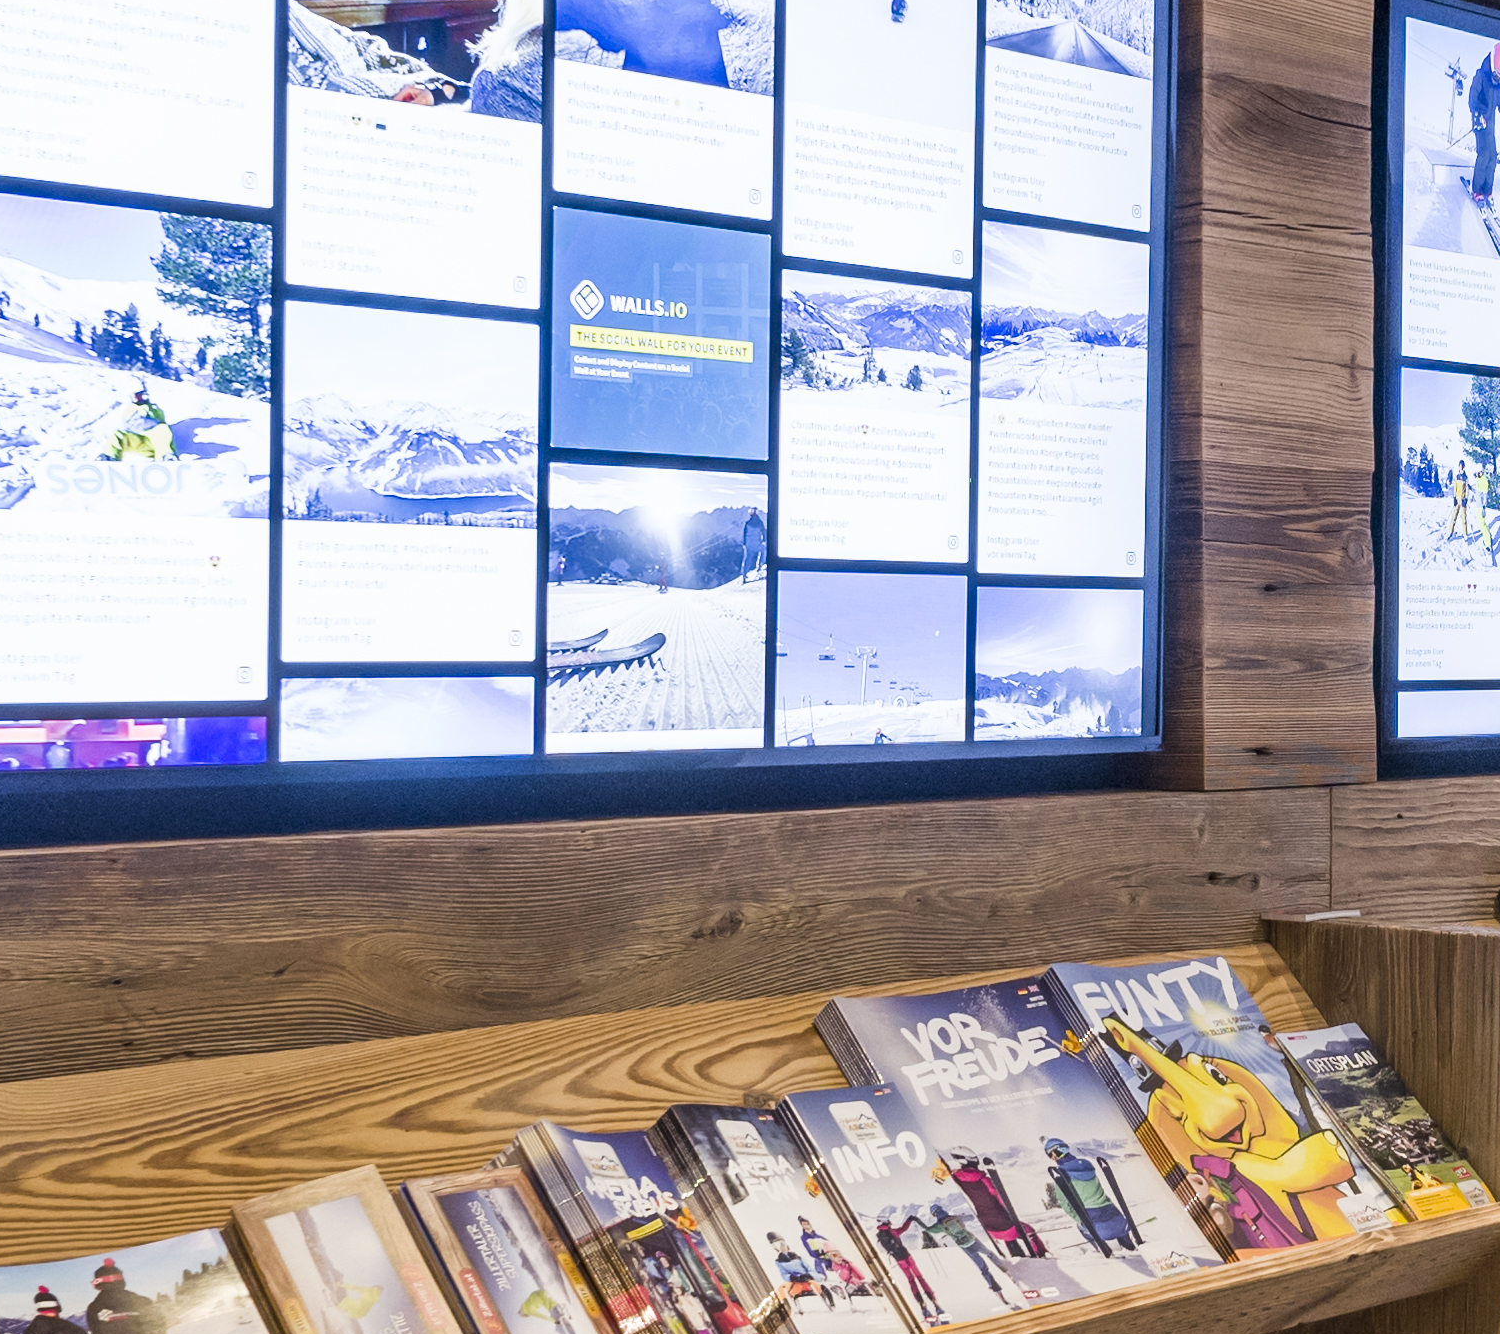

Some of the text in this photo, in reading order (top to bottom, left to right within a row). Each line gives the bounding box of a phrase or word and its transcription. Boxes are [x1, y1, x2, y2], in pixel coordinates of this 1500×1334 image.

[610, 295, 687, 318] WALLS.IO
[577, 331, 747, 356] THE SOCIAL WALL FOR YOUR EVENT
[1073, 957, 1238, 1033] FUNTY
[901, 1013, 997, 1061] VOR
[901, 1026, 1060, 1106] FREUDE
[1306, 1050, 1378, 1073] ORTSPLAN
[728, 1155, 795, 1178] ARENA
[832, 1131, 926, 1183] INFO
[585, 1175, 659, 1201] ARENA
[748, 1175, 800, 1204] FUN
[614, 1191, 679, 1218] SKIBUS
[466, 1200, 521, 1279] SUPERSKIPASS
[465, 1223, 512, 1290] ZILLERTALER
